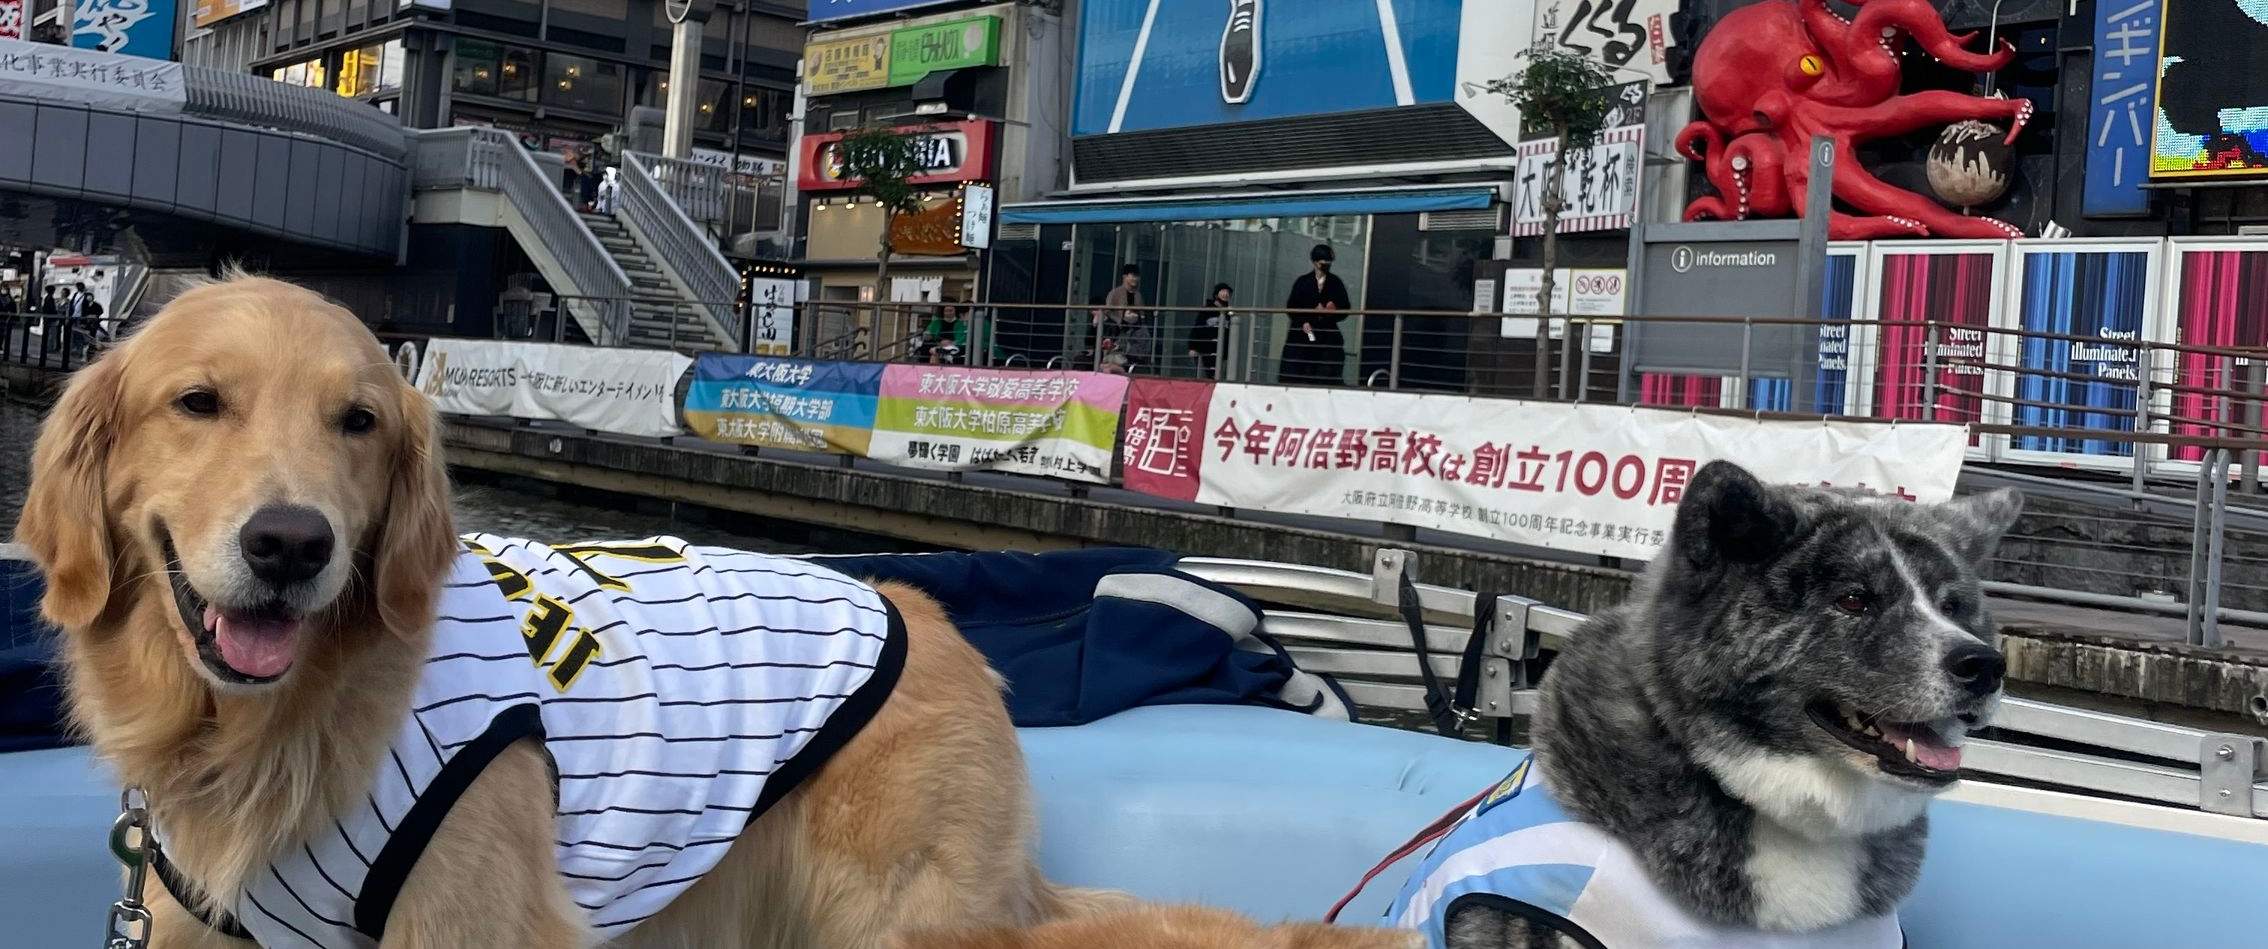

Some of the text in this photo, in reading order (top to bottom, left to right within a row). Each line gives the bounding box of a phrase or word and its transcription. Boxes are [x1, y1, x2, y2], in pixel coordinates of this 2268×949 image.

[1695, 250, 1776, 266] information
[745, 361, 813, 386] 東大阪大学
